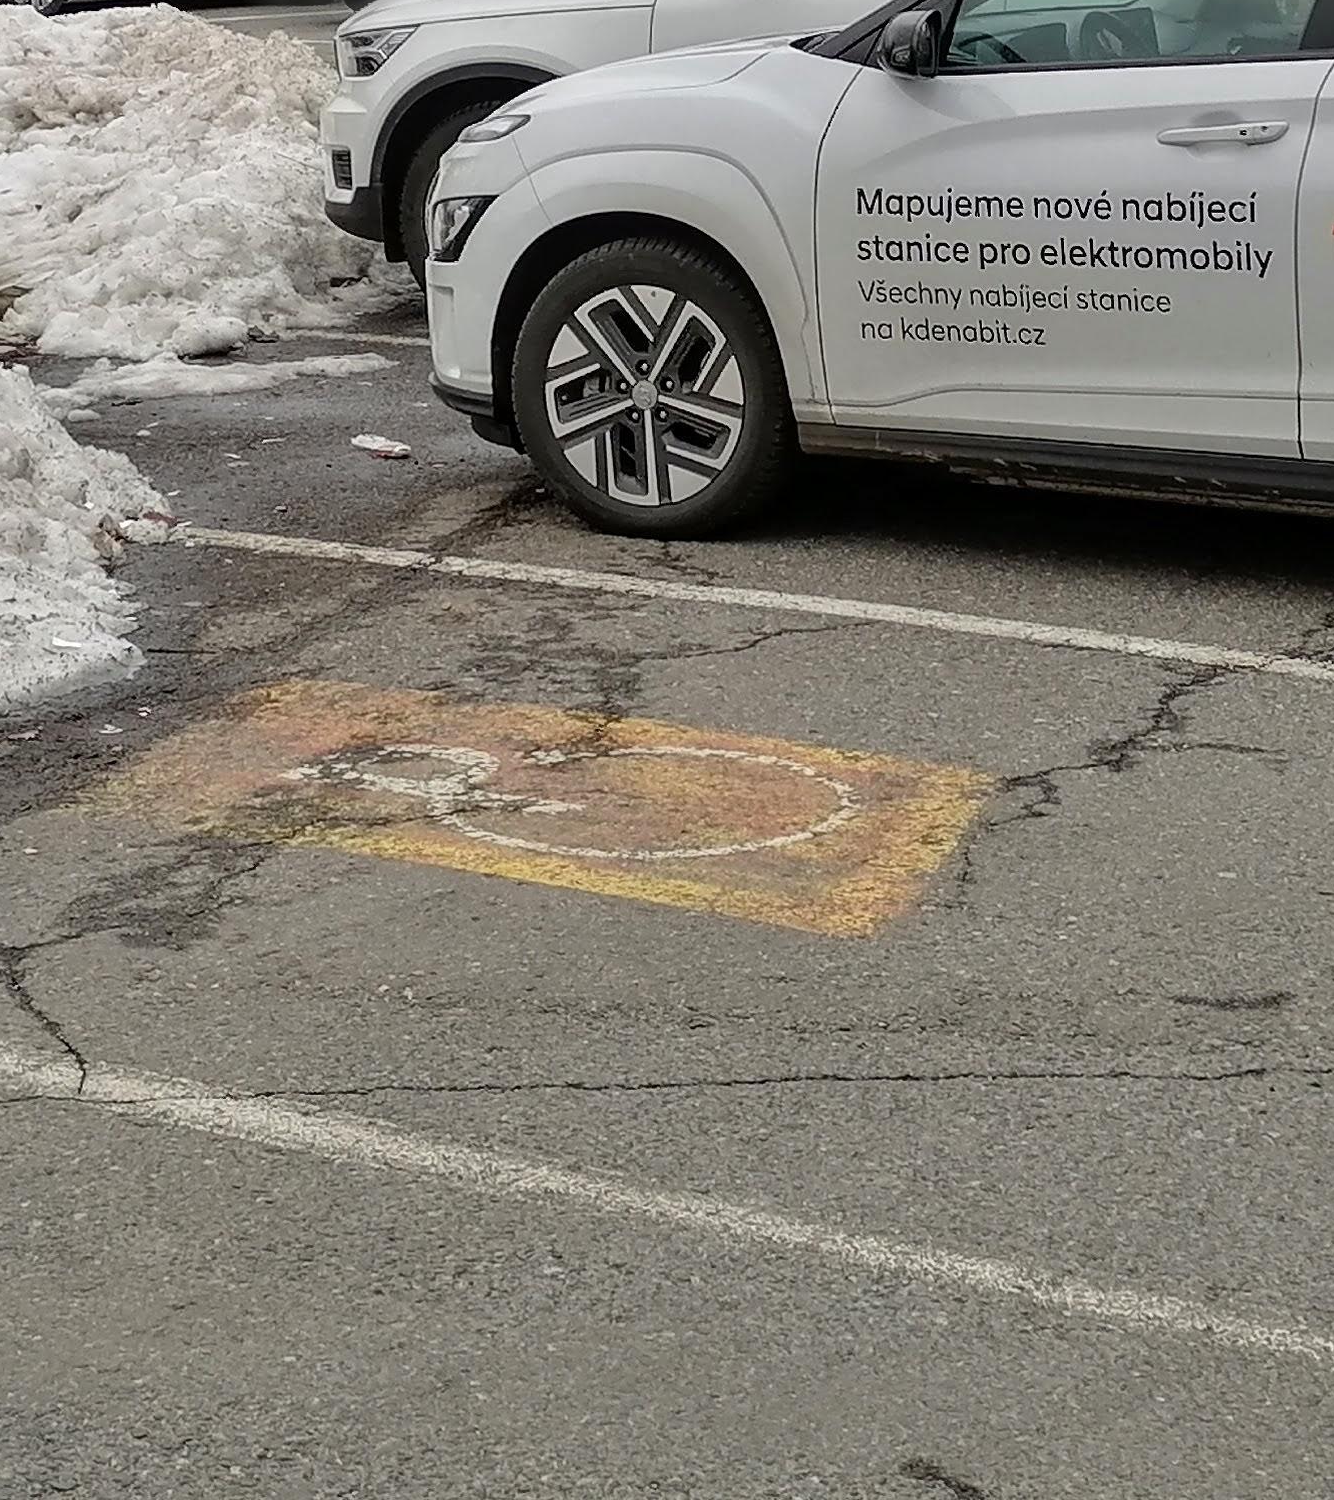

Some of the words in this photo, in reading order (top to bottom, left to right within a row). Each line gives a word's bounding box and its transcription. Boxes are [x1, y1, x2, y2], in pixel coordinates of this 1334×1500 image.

[856, 187, 1025, 223] Mapujeme
[1033, 190, 1112, 220] nové
[1122, 190, 1257, 229] nabíjecí
[856, 233, 970, 263] stanice
[979, 241, 1031, 270] pro
[1040, 237, 1273, 278] elektromobily
[858, 279, 962, 310] Všechny
[970, 284, 1069, 313] nabíjecí
[1076, 287, 1172, 313] stanice
[861, 319, 893, 341] na
[901, 316, 1046, 346] kdenabit.cz
